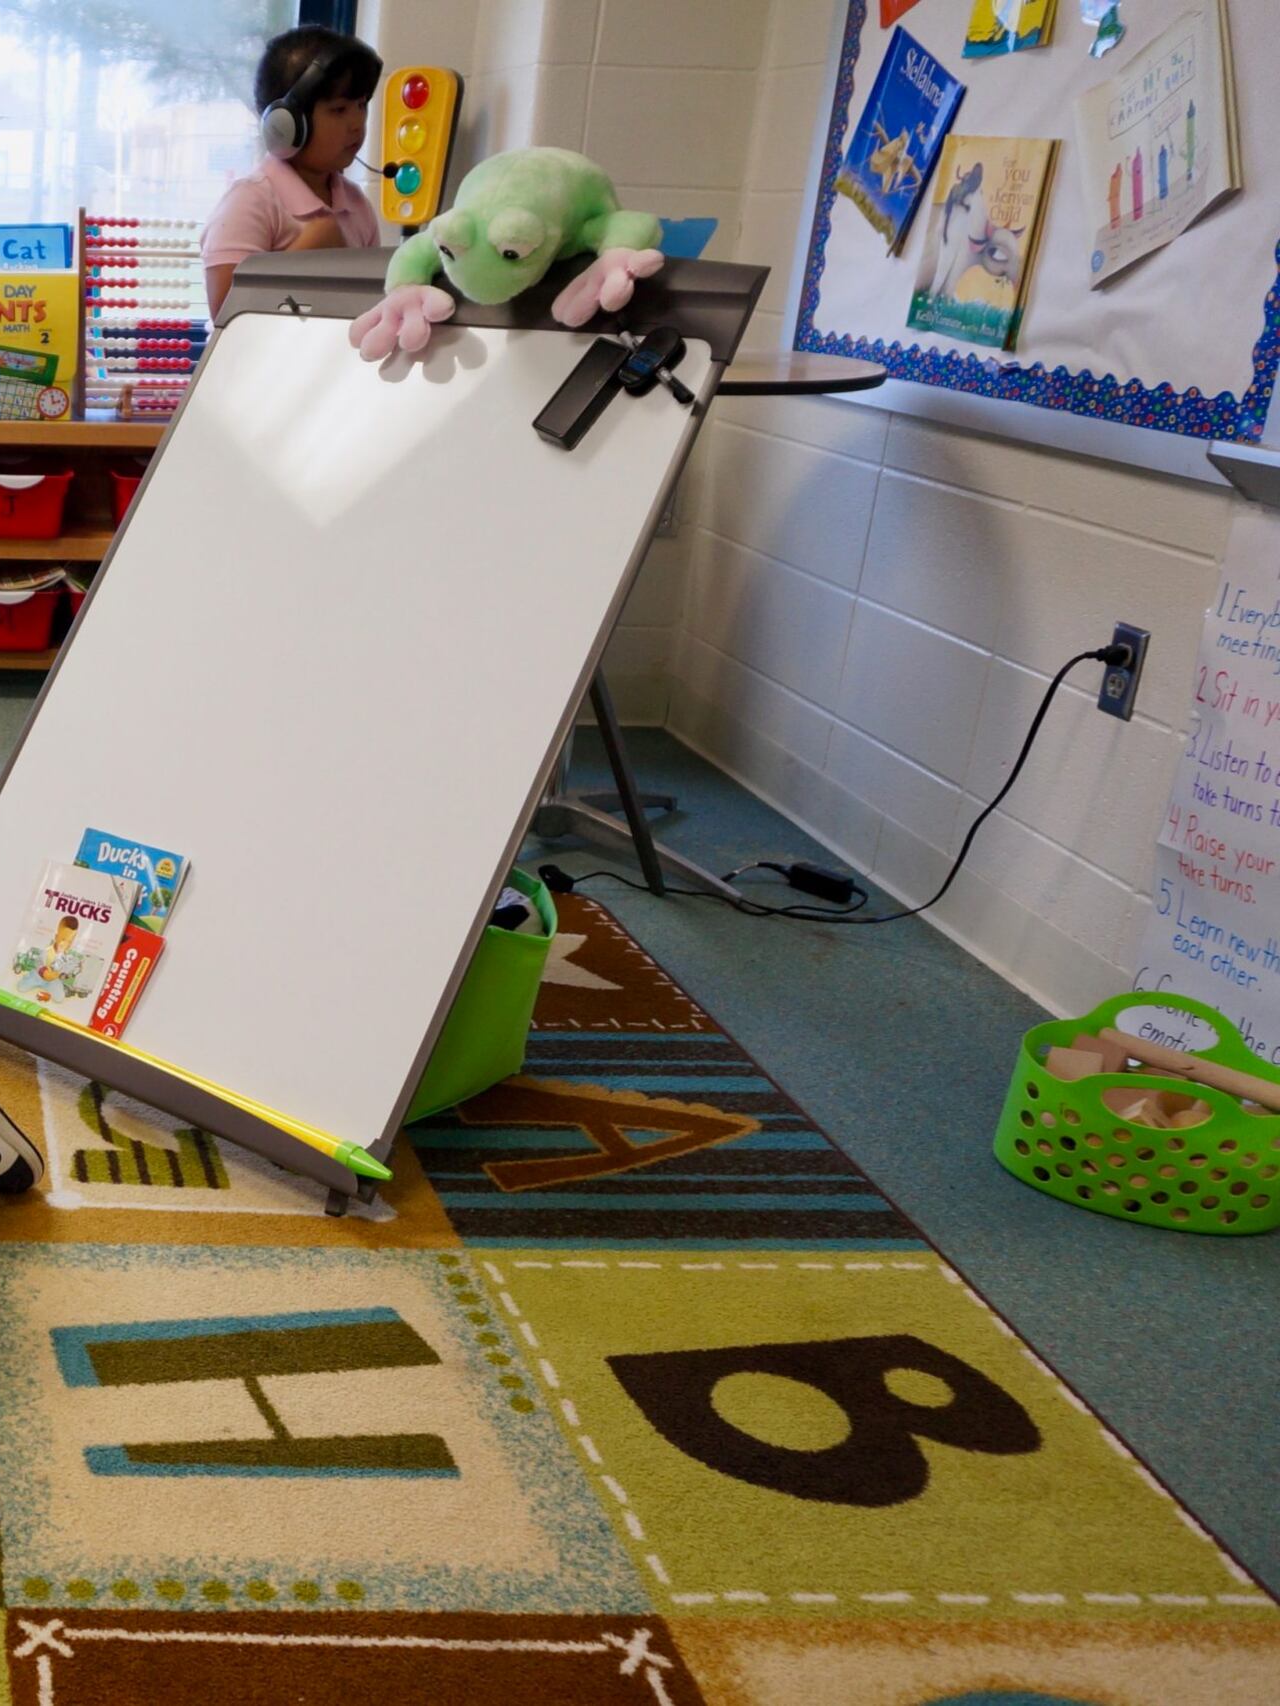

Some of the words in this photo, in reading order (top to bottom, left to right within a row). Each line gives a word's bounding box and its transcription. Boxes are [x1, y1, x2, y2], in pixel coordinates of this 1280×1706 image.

[900, 47, 945, 108] Stellaluna
[1004, 167, 1031, 188] you
[994, 187, 1035, 207] Kenyan
[990, 205, 1022, 223] Child
[2, 239, 47, 260] Cat
[4, 284, 37, 298] DAY
[3, 323, 31, 333] MATH
[915, 309, 936, 328] Kelly
[39, 332, 50, 344] 2
[2, 494, 16, 518] J
[1210, 670, 1239, 713] Sit
[1242, 688, 1260, 719] in
[1199, 723, 1249, 778] Listen
[1255, 750, 1272, 784] to
[1193, 771, 1218, 808] take
[1223, 785, 1264, 822] turns
[97, 841, 150, 870] Ducks
[1182, 813, 1227, 861] Raise
[1233, 847, 1276, 875] your
[122, 865, 137, 879] in
[1176, 851, 1206, 888] take
[1209, 864, 1257, 905] turns.
[44, 888, 112, 924] TRUCKS
[1176, 887, 1225, 946] Learn
[1229, 930, 1260, 963] new
[1171, 933, 1206, 964] each
[96, 948, 138, 1019] Counting
[1237, 1015, 1267, 1058] the
